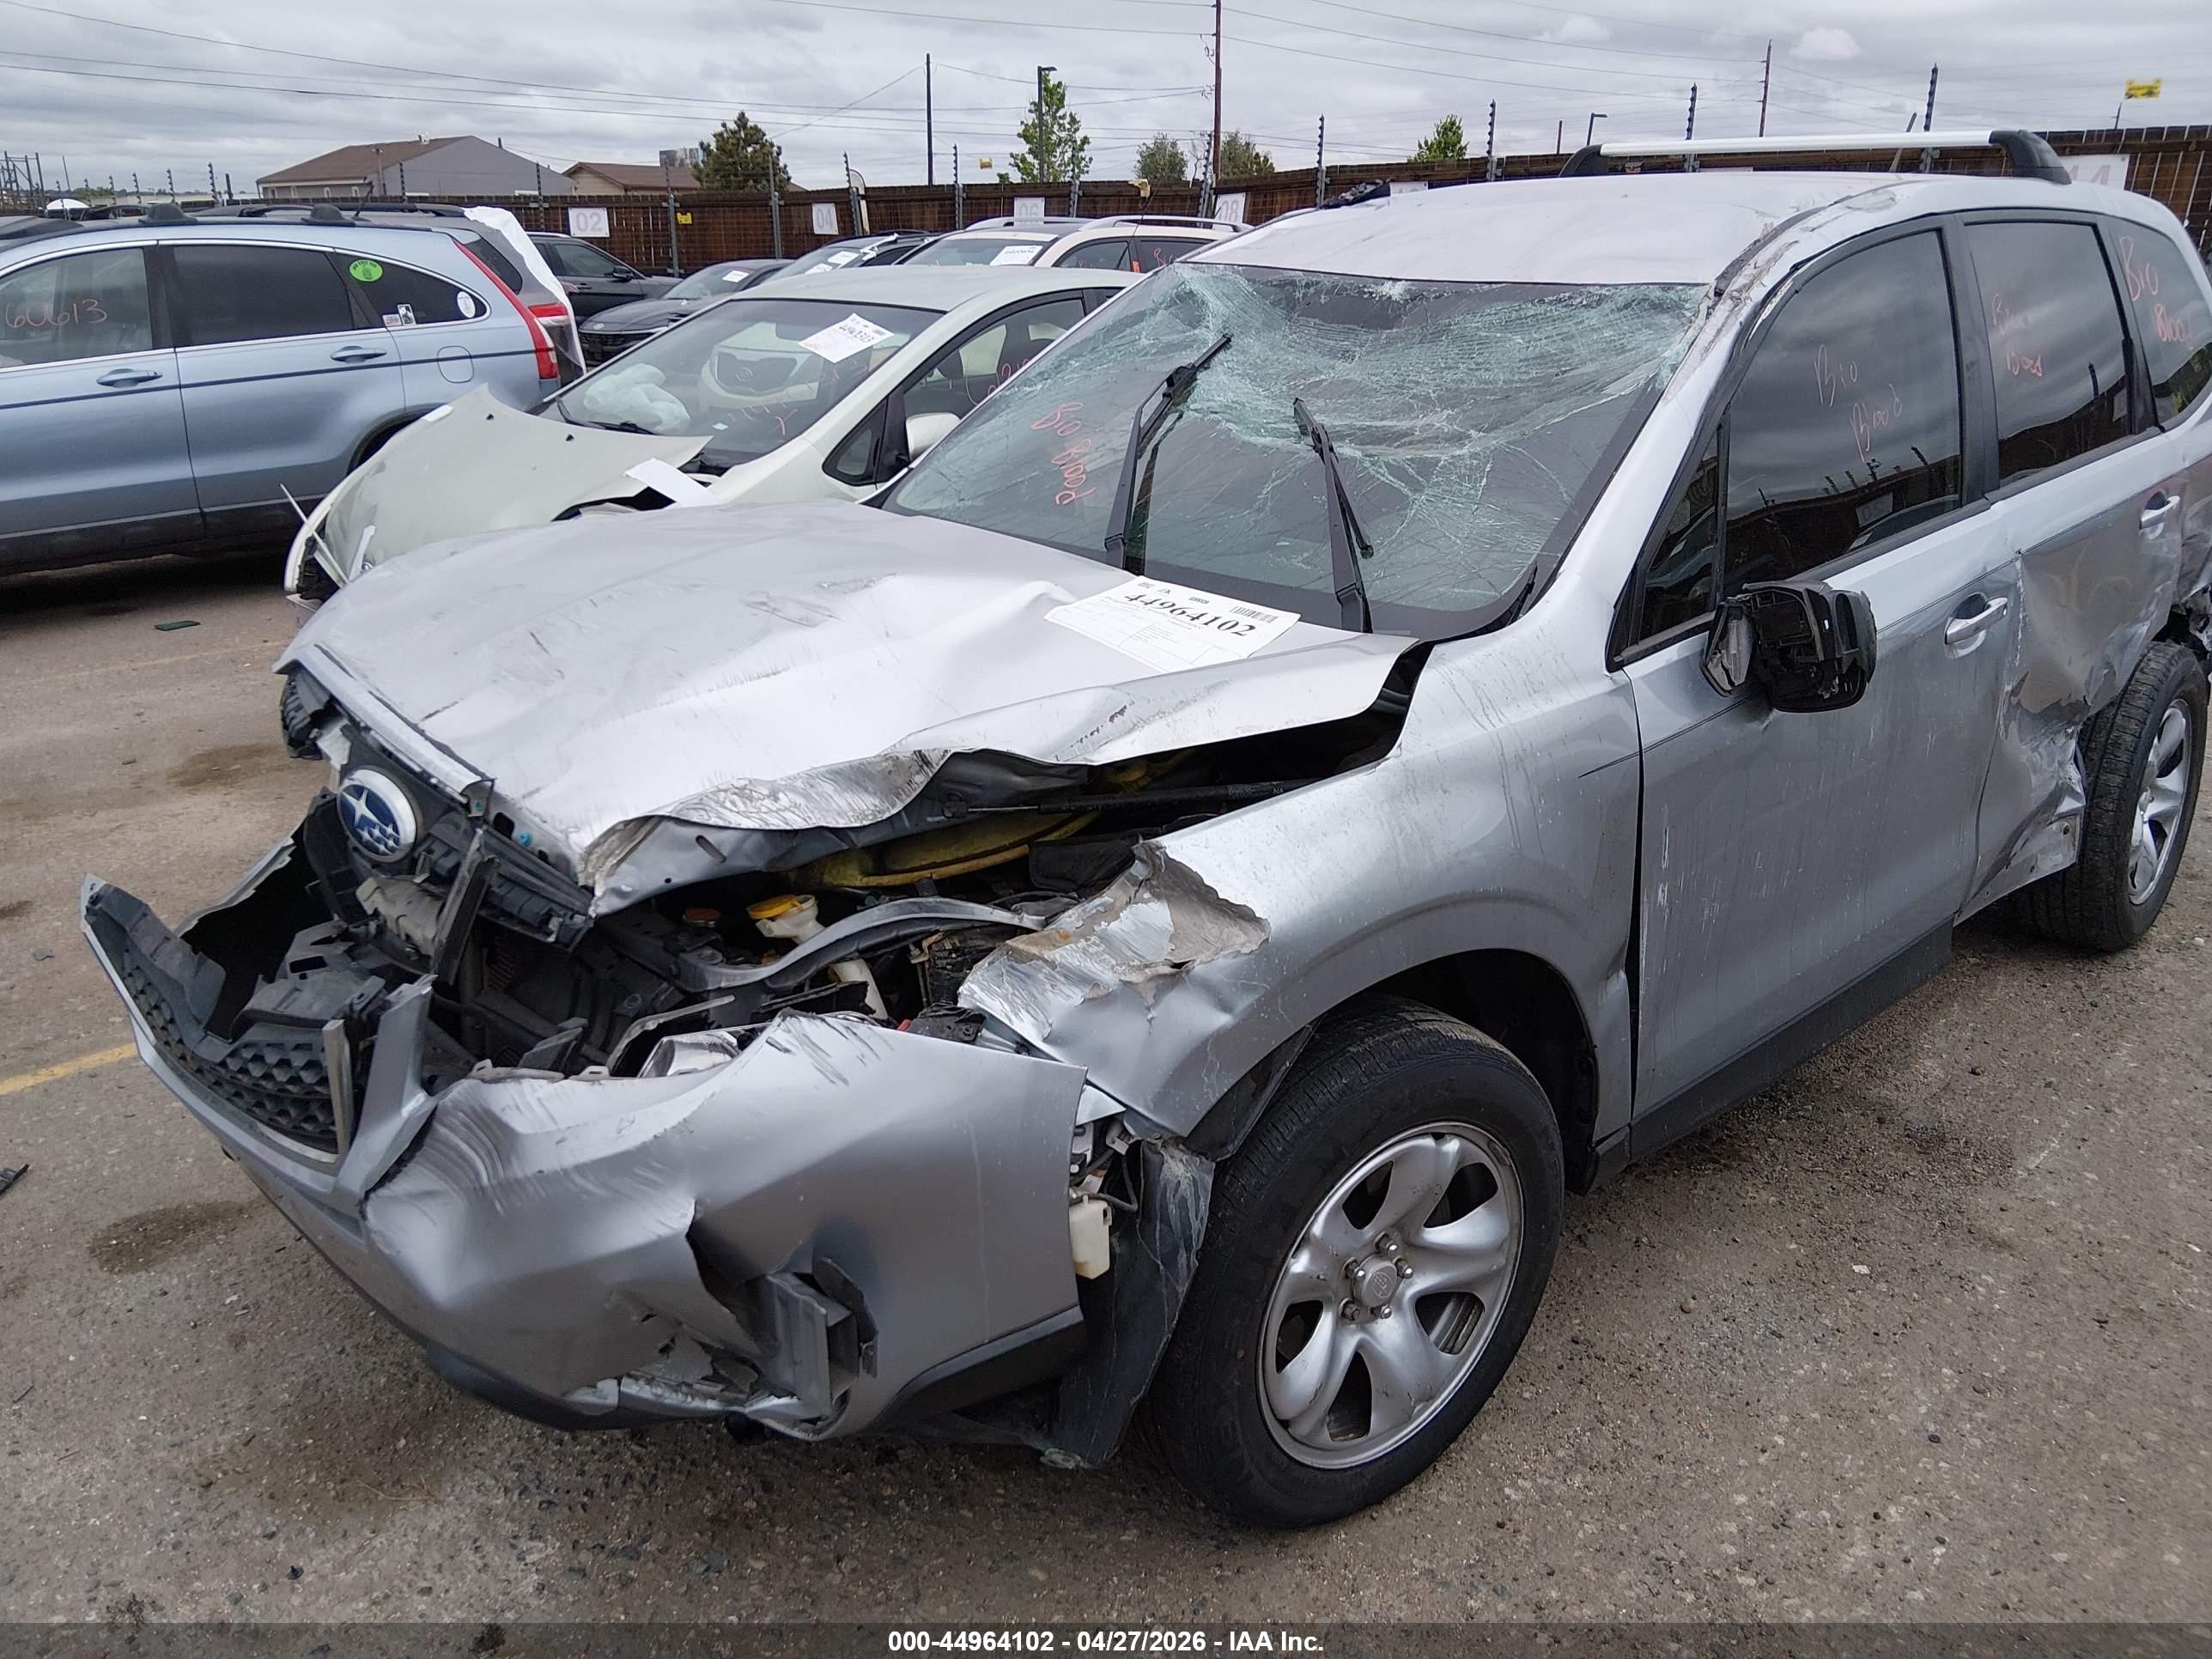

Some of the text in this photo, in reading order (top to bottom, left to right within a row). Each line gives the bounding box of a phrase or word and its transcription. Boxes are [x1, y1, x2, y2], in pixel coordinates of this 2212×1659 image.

[576, 212, 603, 232] 02
[817, 208, 834, 228] 04
[1814, 343, 1858, 407] Bio
[1124, 593, 1256, 636] 44964102
